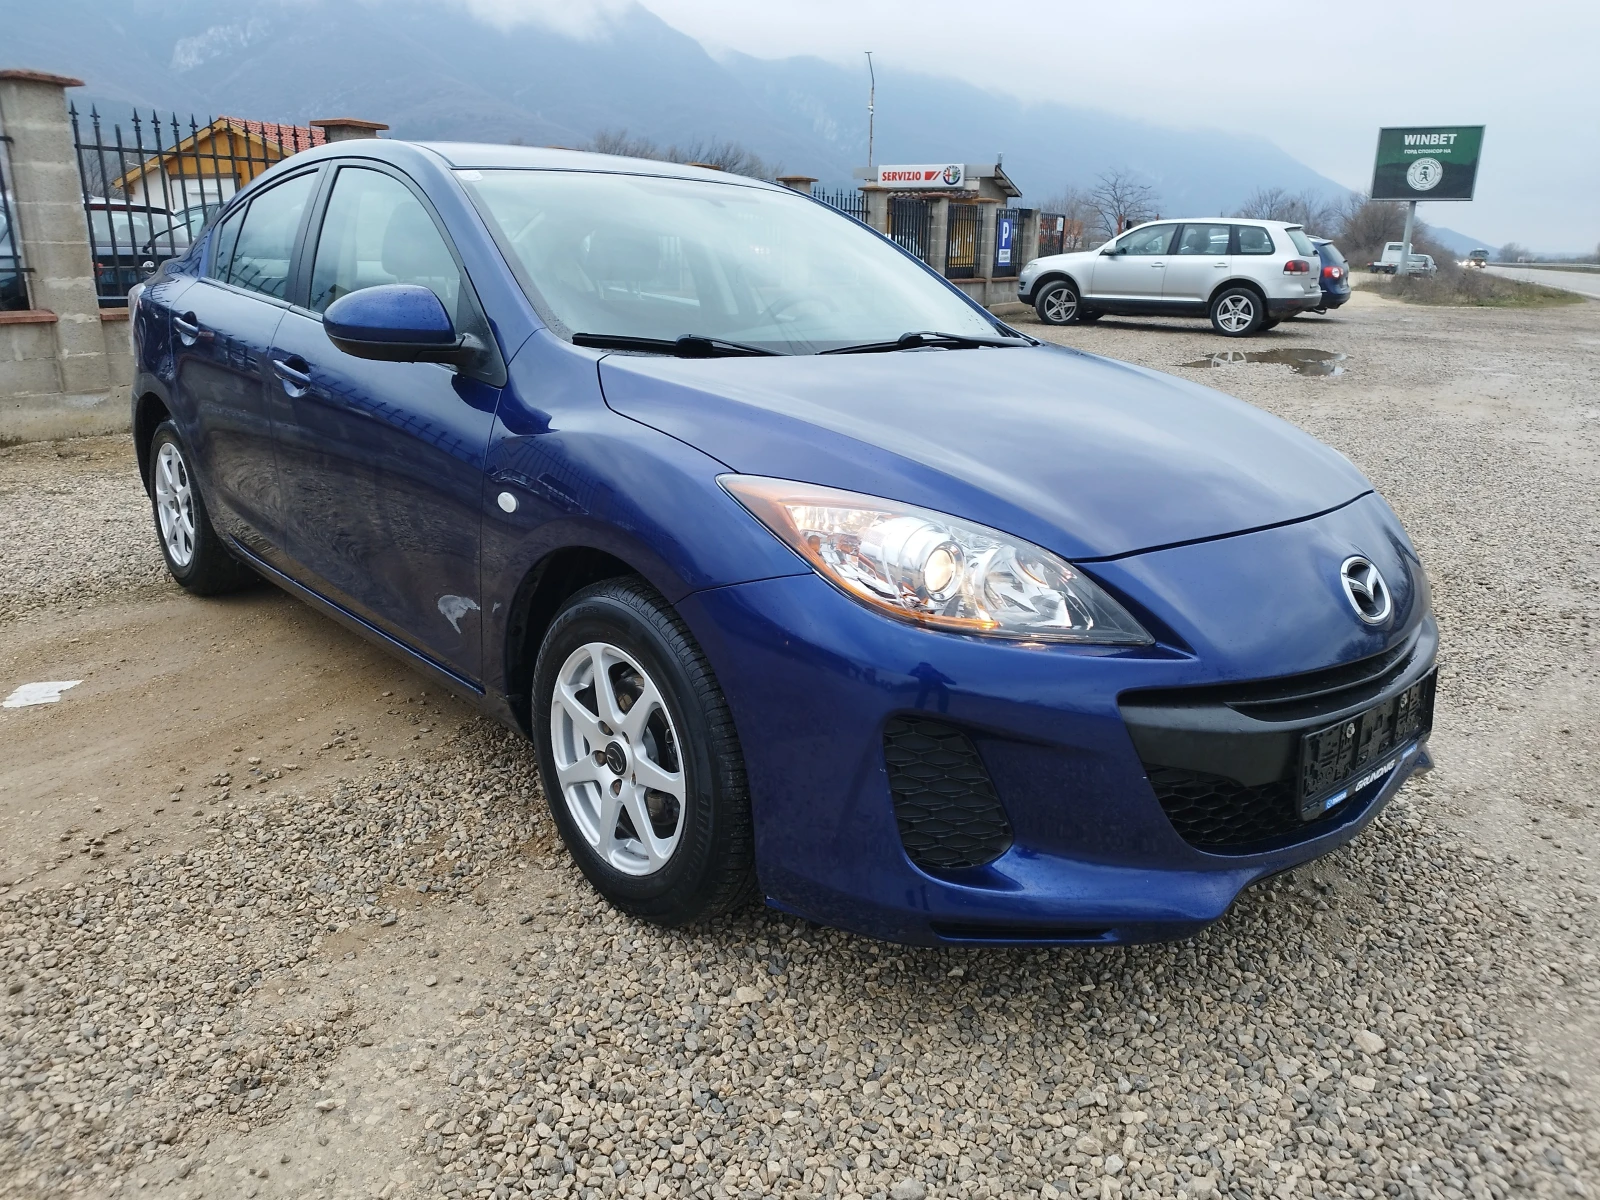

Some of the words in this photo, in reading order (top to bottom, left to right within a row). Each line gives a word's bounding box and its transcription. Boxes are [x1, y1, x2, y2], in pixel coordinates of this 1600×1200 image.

[1404, 134, 1457, 145] WINBET
[882, 171, 921, 181] SERVIZIO
[1002, 221, 1009, 247] P
